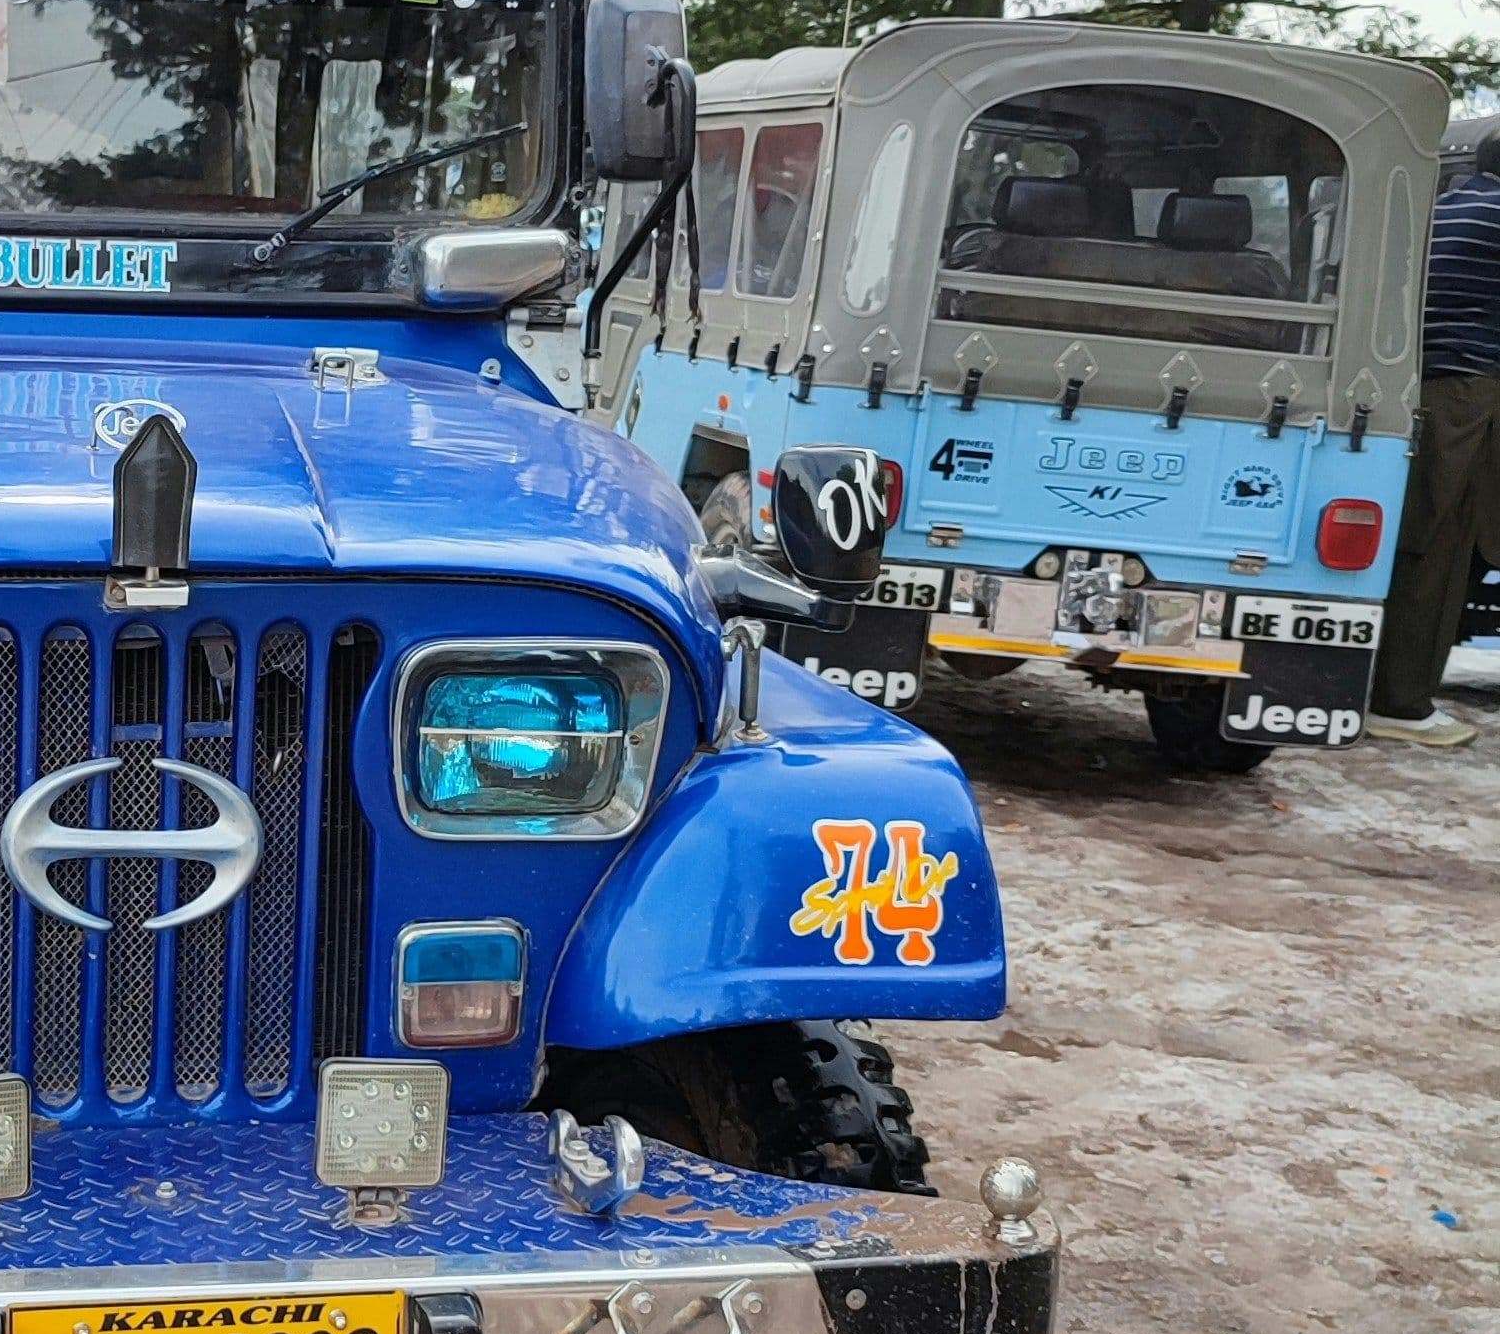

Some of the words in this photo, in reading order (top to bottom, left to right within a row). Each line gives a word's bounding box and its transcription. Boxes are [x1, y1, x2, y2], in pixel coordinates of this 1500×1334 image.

[929, 438, 956, 481] 4
[956, 439, 994, 450] WHEEL
[1039, 437, 1184, 481] Jeep
[954, 473, 990, 485] DRIVE
[818, 449, 888, 551] OK
[1241, 612, 1281, 637] BE
[1292, 616, 1375, 644] 0613
[1228, 694, 1361, 746] Jeep
[98, 1302, 327, 1333] KARACHI
